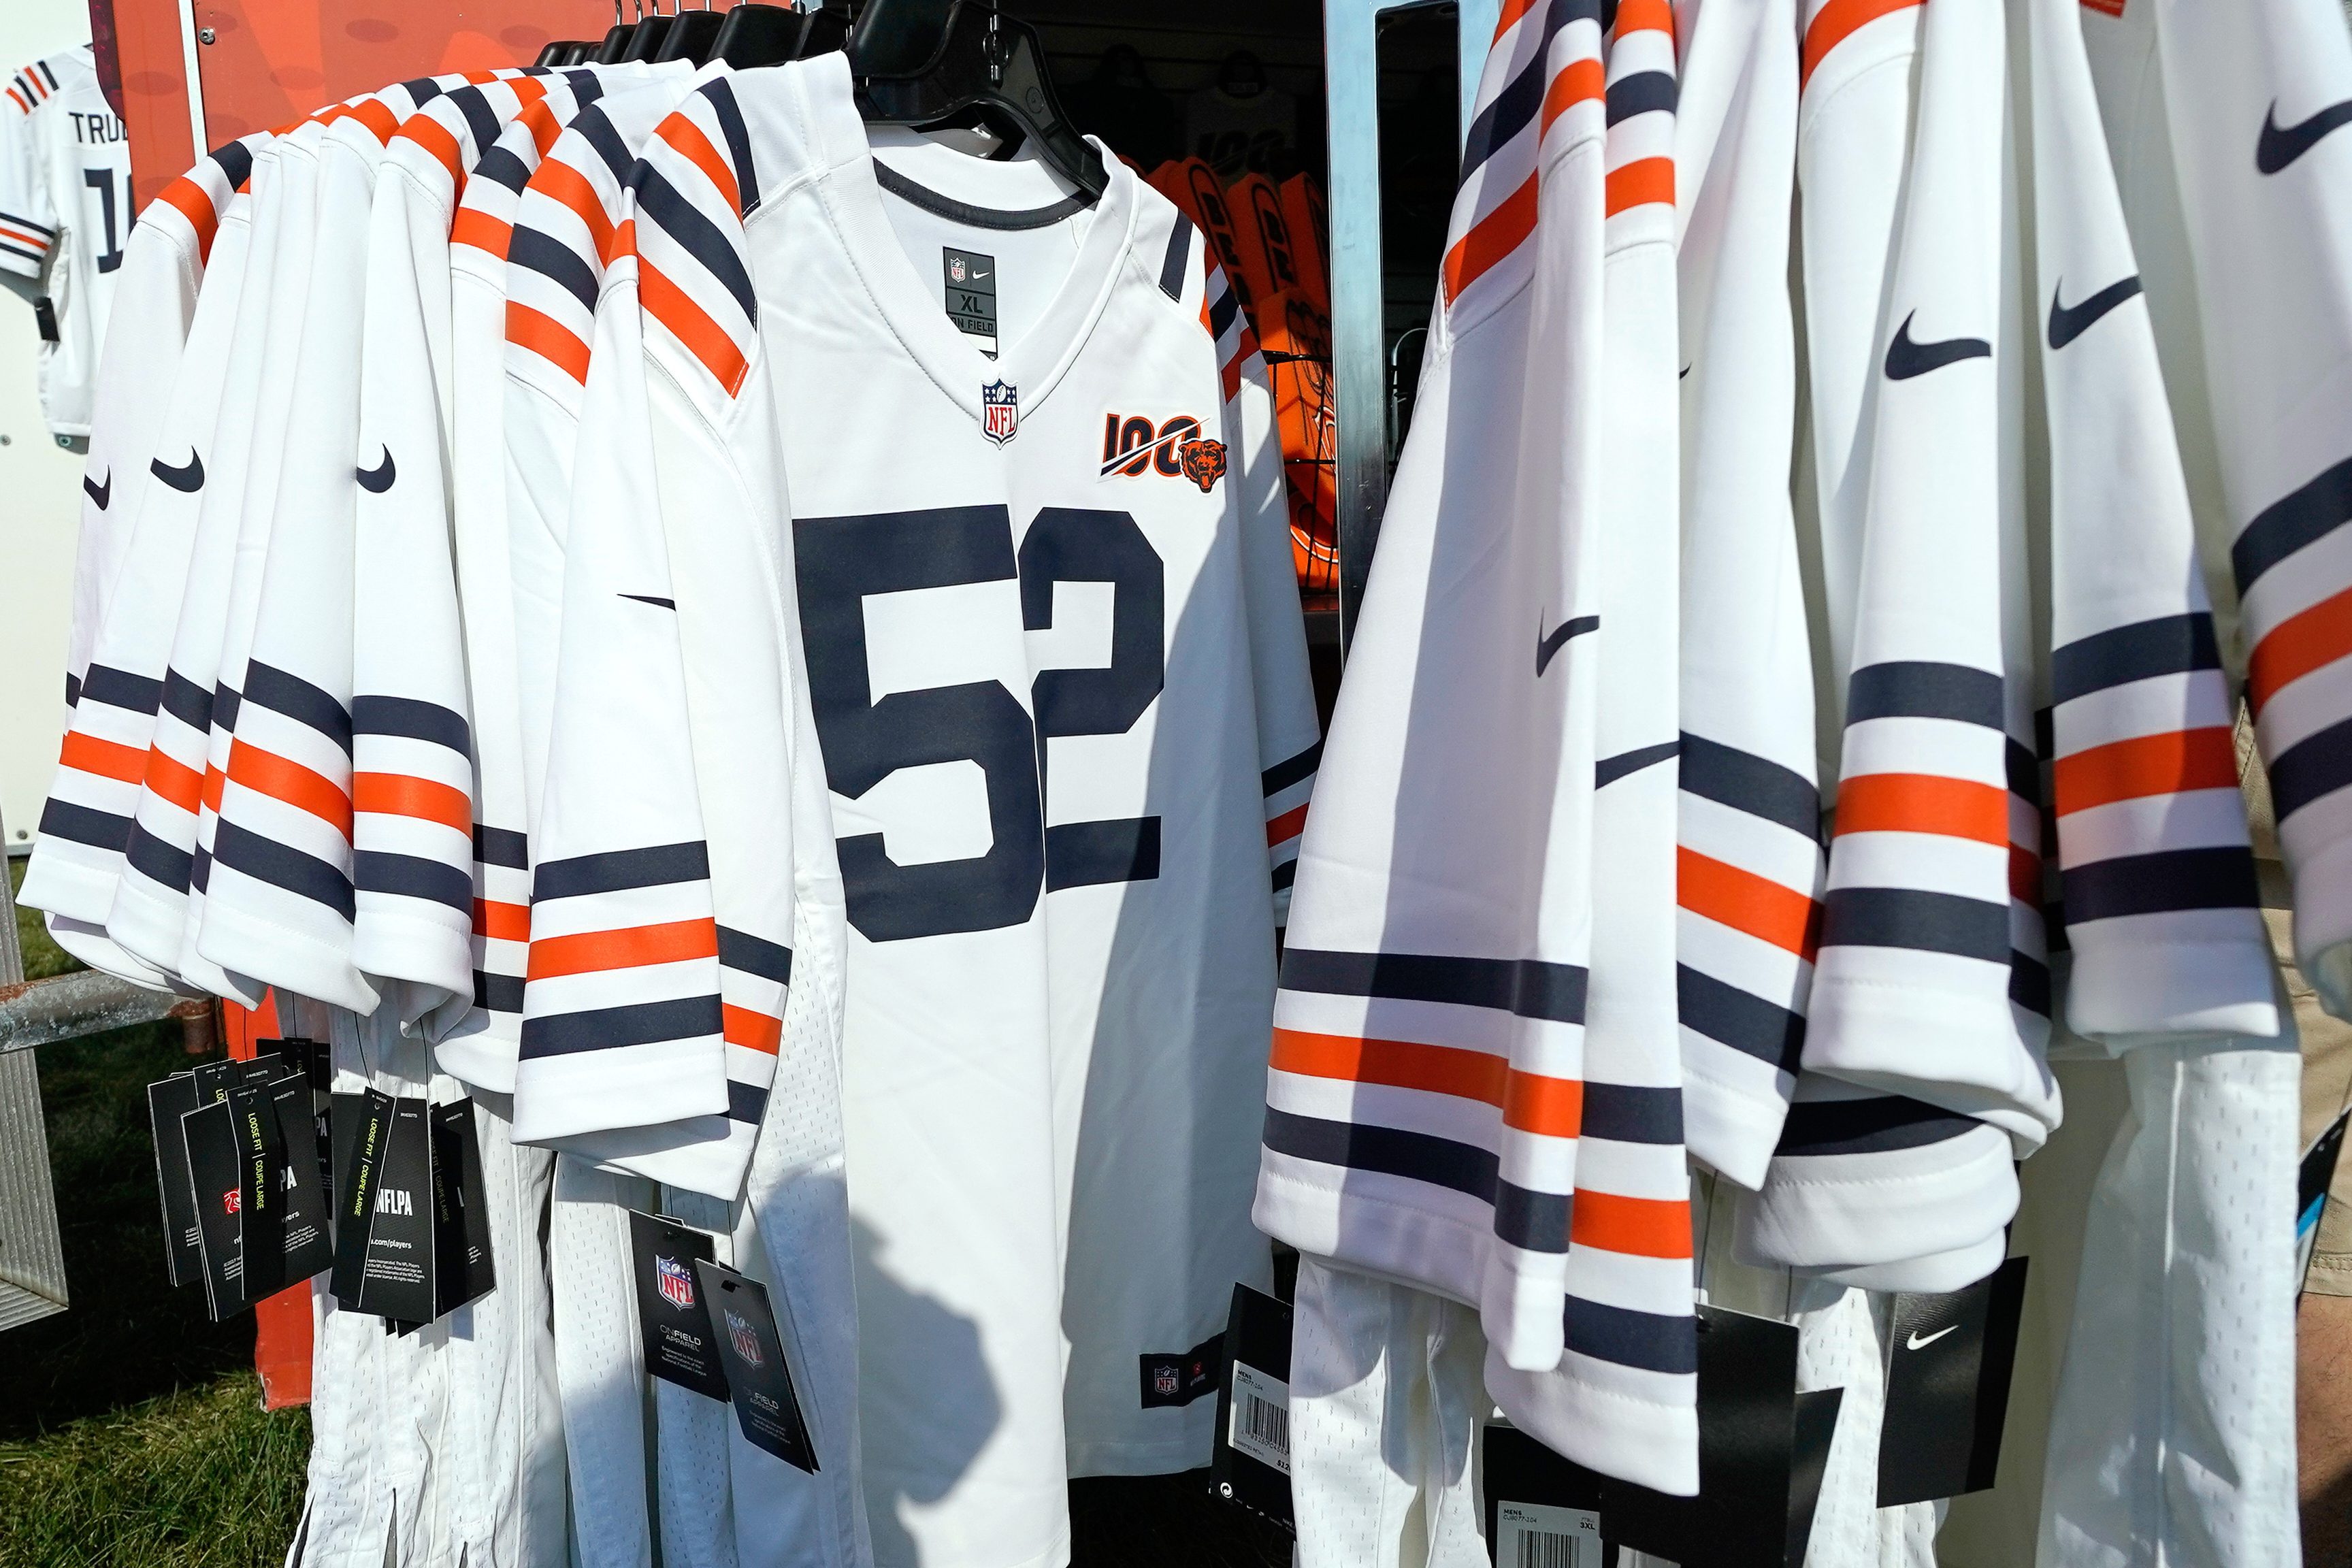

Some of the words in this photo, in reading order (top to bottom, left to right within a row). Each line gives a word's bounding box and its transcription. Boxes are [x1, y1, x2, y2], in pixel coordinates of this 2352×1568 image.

[84, 169, 137, 274] 1
[952, 267, 964, 279] NFL
[960, 294, 983, 314] XL
[968, 319, 994, 333] FIELD
[987, 406, 1017, 436] NFL
[1100, 412, 1203, 478] 100
[792, 504, 1164, 943] 52
[248, 1112, 261, 1139] LOOSE
[368, 1117, 378, 1144] LOOSE
[253, 1139, 263, 1152] FIT
[365, 1143, 374, 1157] FIT
[255, 1160, 264, 1185] COUPE
[358, 1164, 369, 1191] COUPE
[256, 1186, 265, 1211] LARGE
[354, 1190, 365, 1217] LARGE
[376, 1188, 413, 1217] NFLPA
[662, 1273, 695, 1305] NFL
[665, 1335, 700, 1352] APPAREL
[1158, 1378, 1175, 1392] NFL
[1237, 1369, 1252, 1380] MENS
[1580, 1522, 1596, 1531] 3XL
